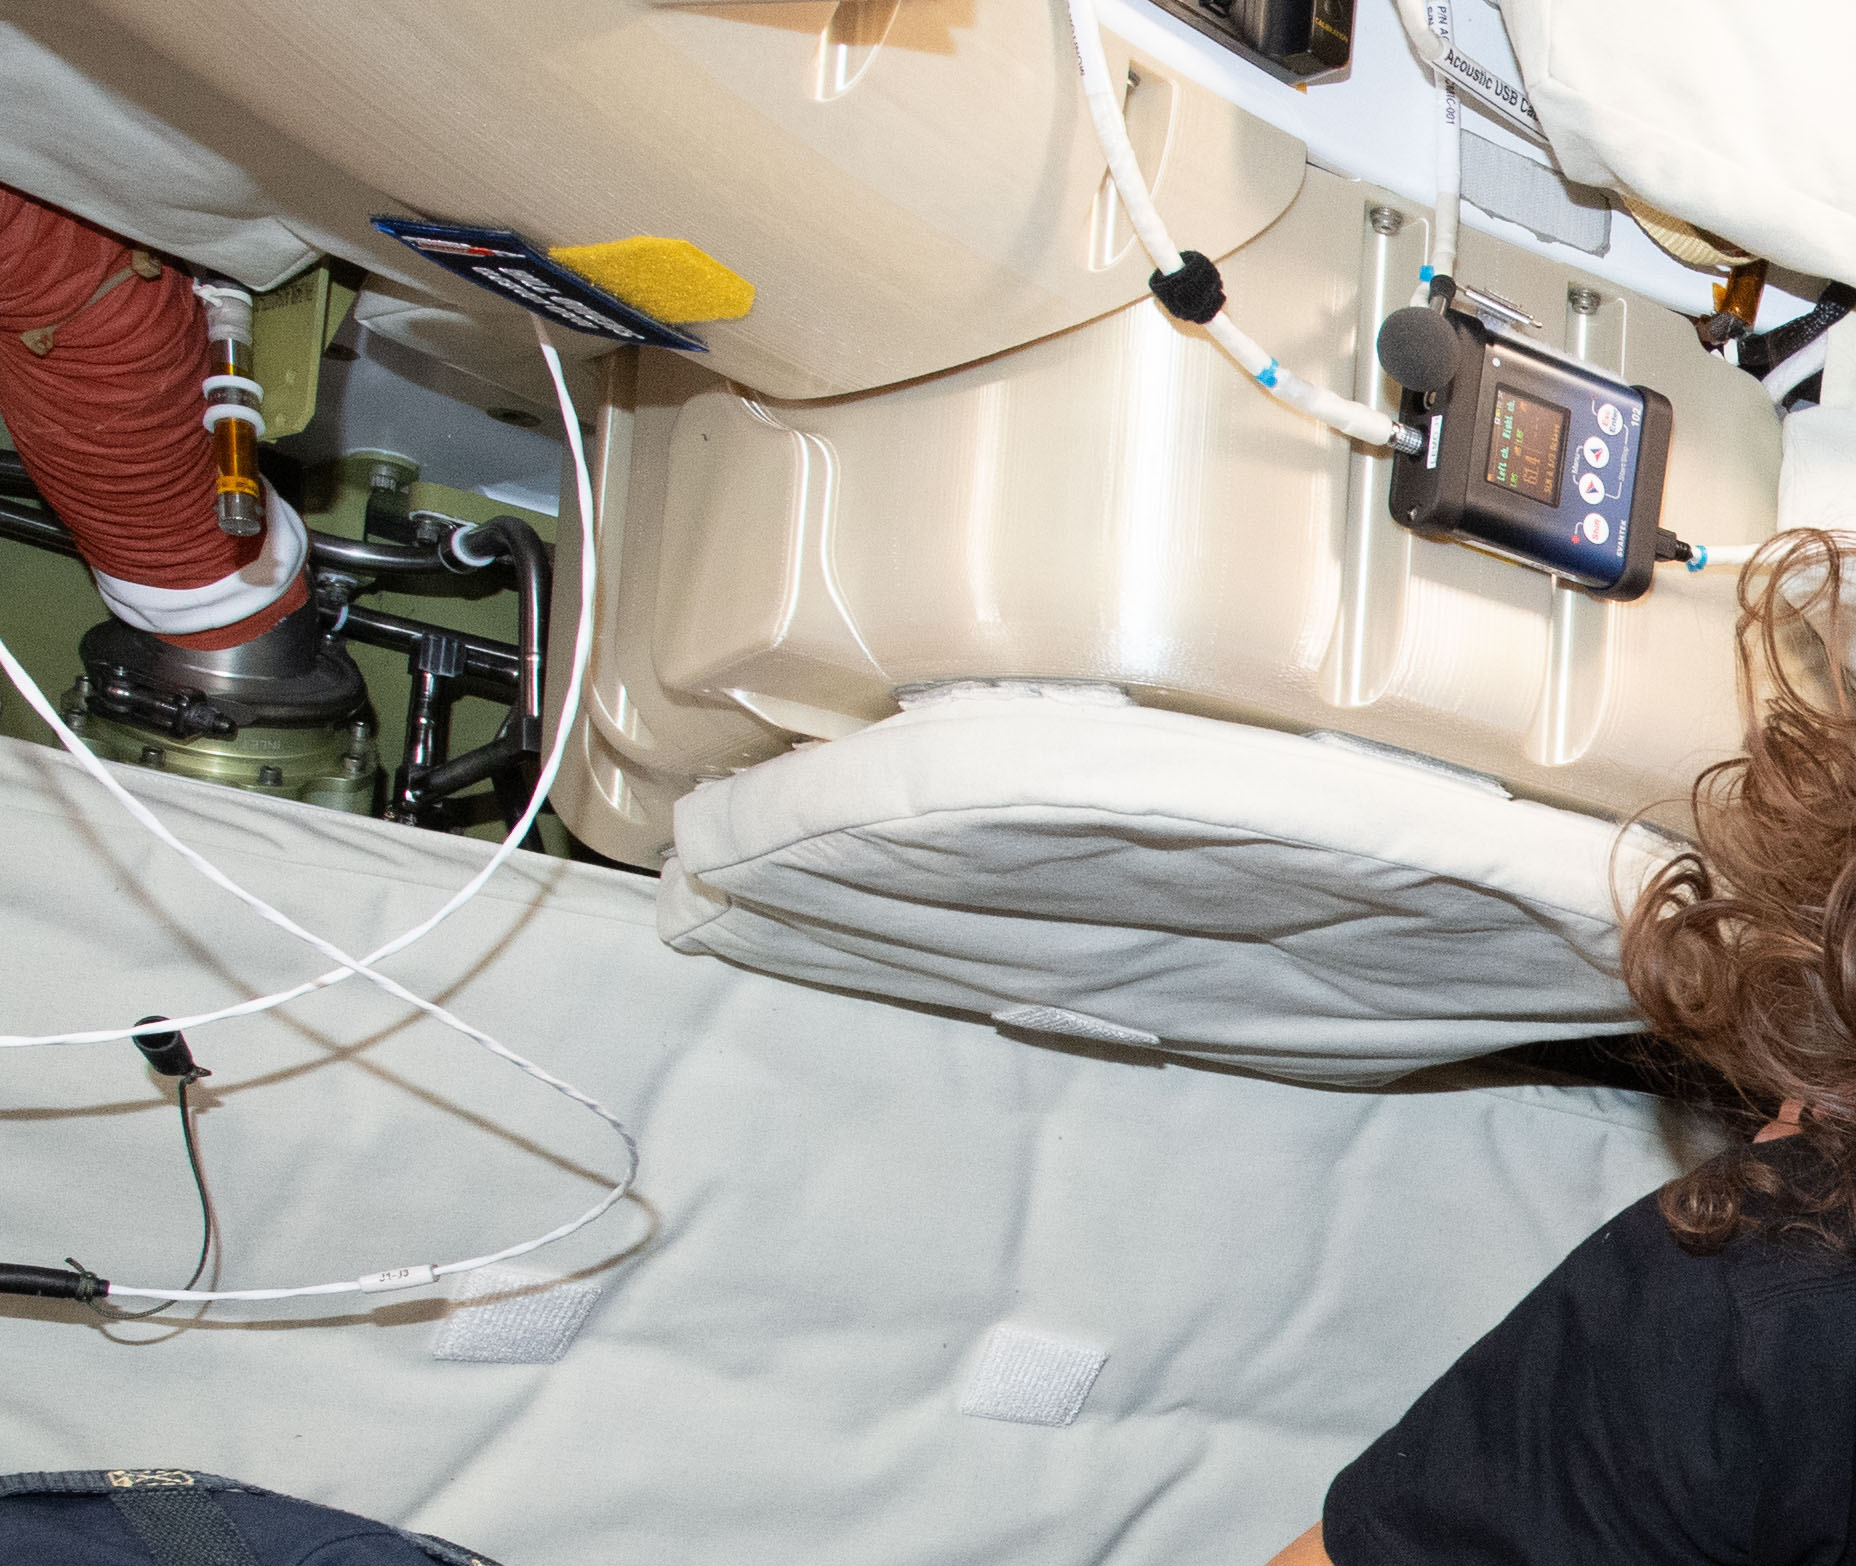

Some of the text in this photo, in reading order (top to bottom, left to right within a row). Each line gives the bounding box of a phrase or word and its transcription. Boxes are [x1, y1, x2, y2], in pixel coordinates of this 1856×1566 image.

[1445, 49, 1493, 90] Acoustic
[1495, 80, 1518, 106] USB
[1609, 410, 1620, 433] Enter
[1631, 406, 1642, 428] 102
[1591, 518, 1601, 542] Shift
[1616, 519, 1628, 558] SVANTEK
